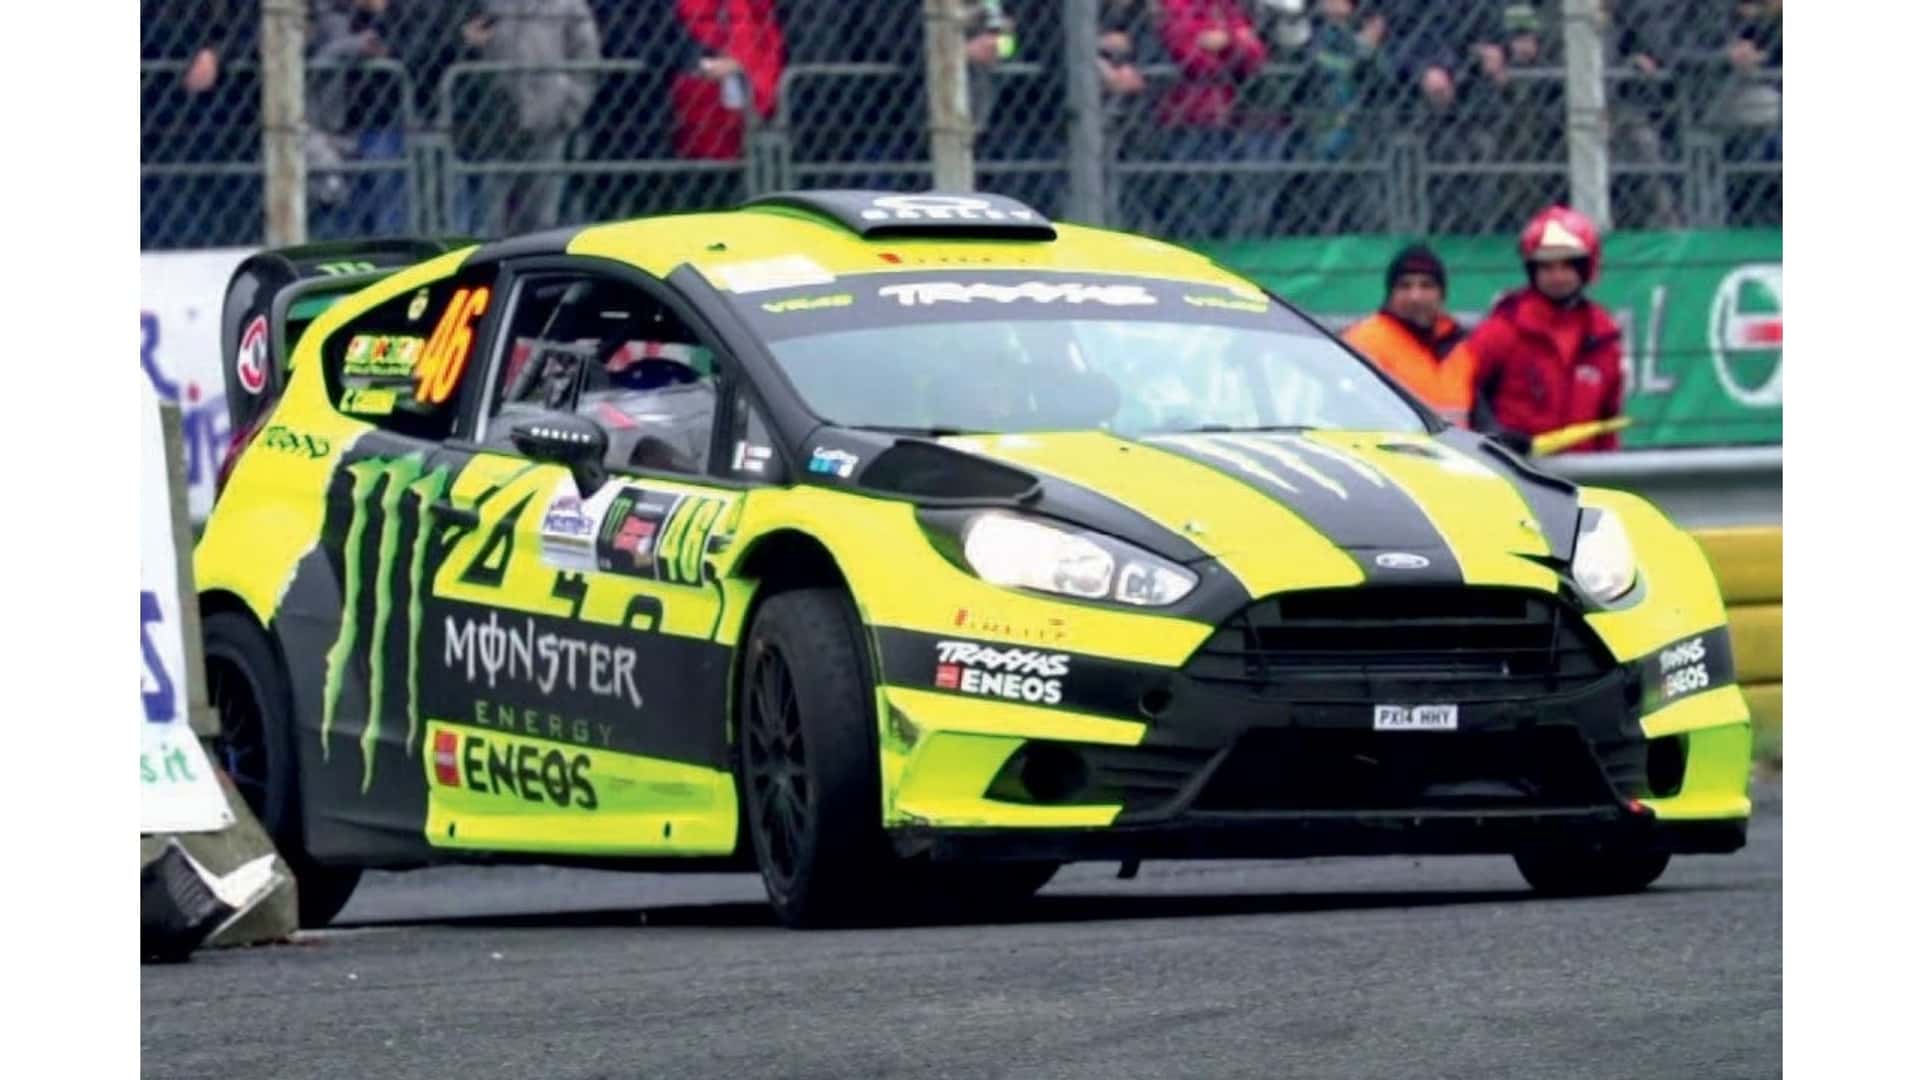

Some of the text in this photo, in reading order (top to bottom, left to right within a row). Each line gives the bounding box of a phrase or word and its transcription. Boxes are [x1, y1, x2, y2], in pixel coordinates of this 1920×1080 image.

[414, 287, 490, 404] 46
[659, 494, 728, 584] 46
[935, 640, 1070, 677] TRAXXAS
[960, 668, 1063, 705] ENEOS
[475, 700, 617, 746] ENERGY
[463, 734, 599, 811] ENEOS
